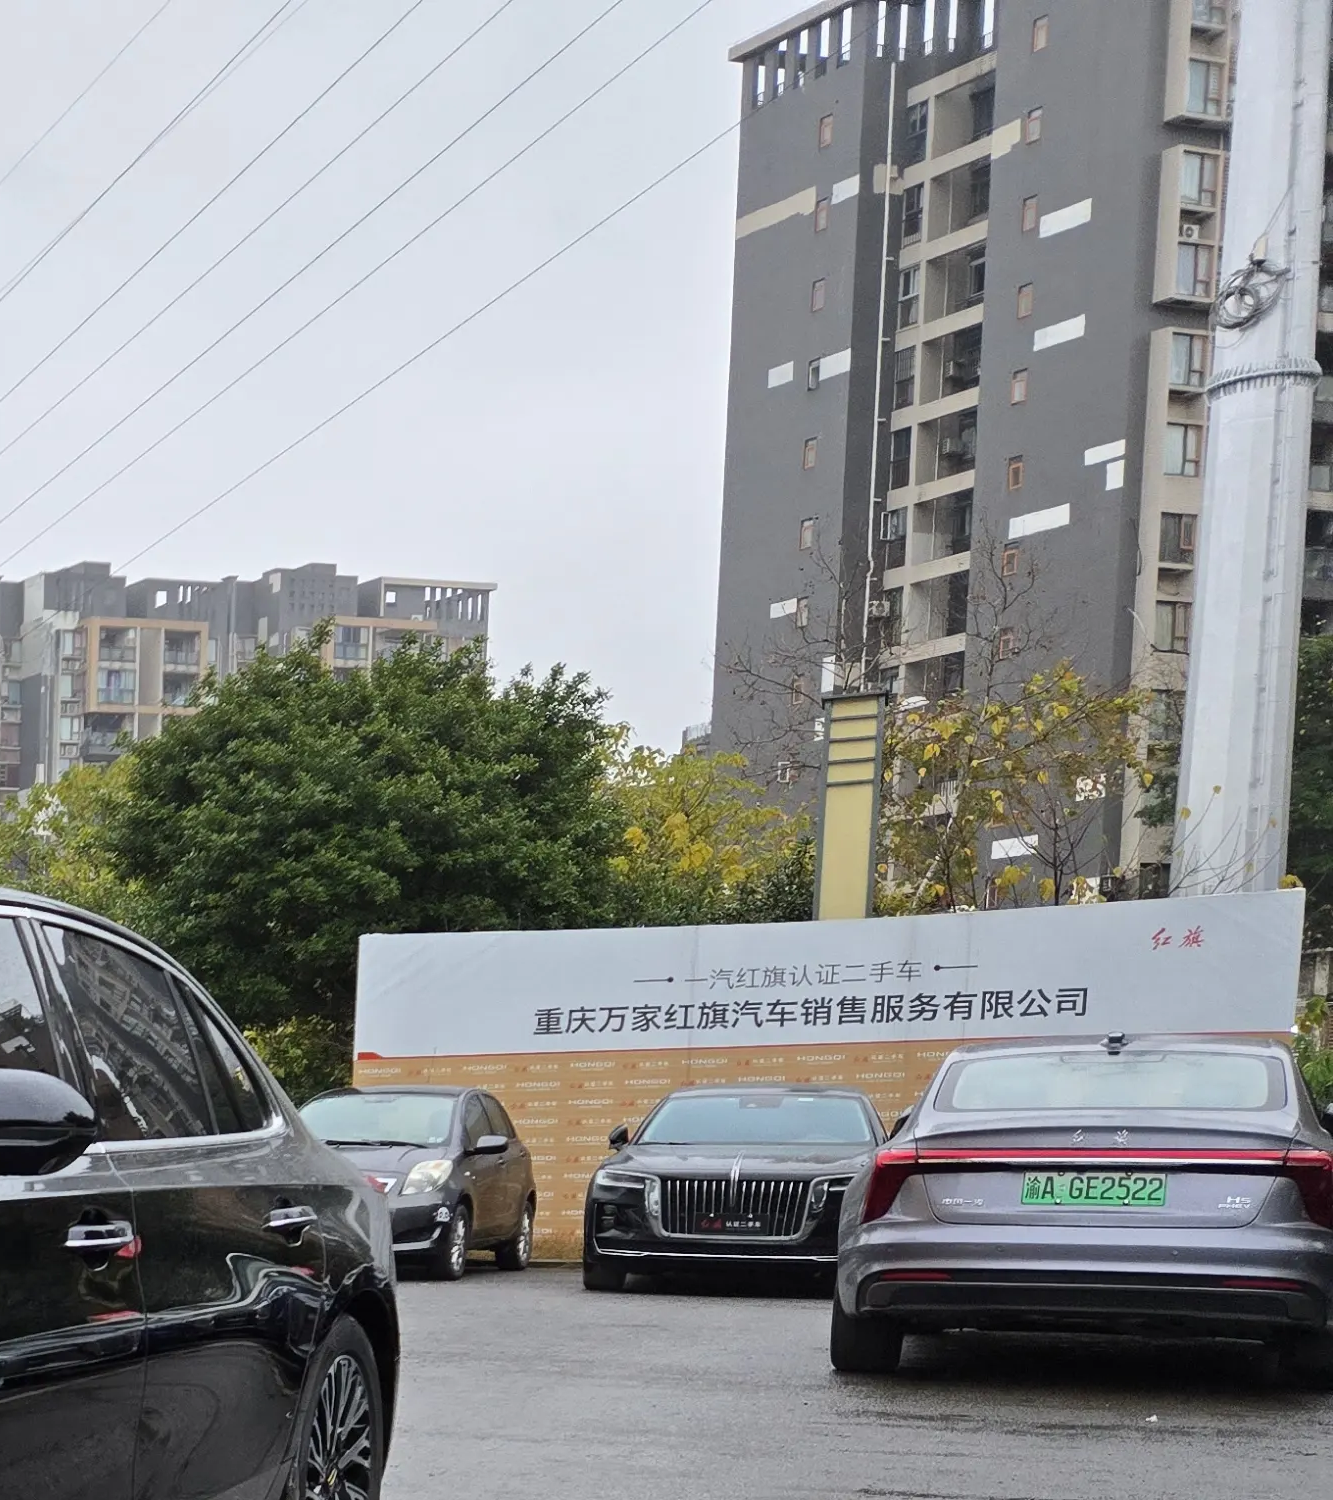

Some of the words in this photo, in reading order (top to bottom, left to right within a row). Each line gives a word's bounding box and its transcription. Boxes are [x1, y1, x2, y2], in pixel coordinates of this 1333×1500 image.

[1150, 925, 1205, 951] 红旗
[684, 959, 923, 991] 一汽红旗认证二手车
[532, 986, 1090, 1036] 重庆万家红旗汽车销售服务有限公司
